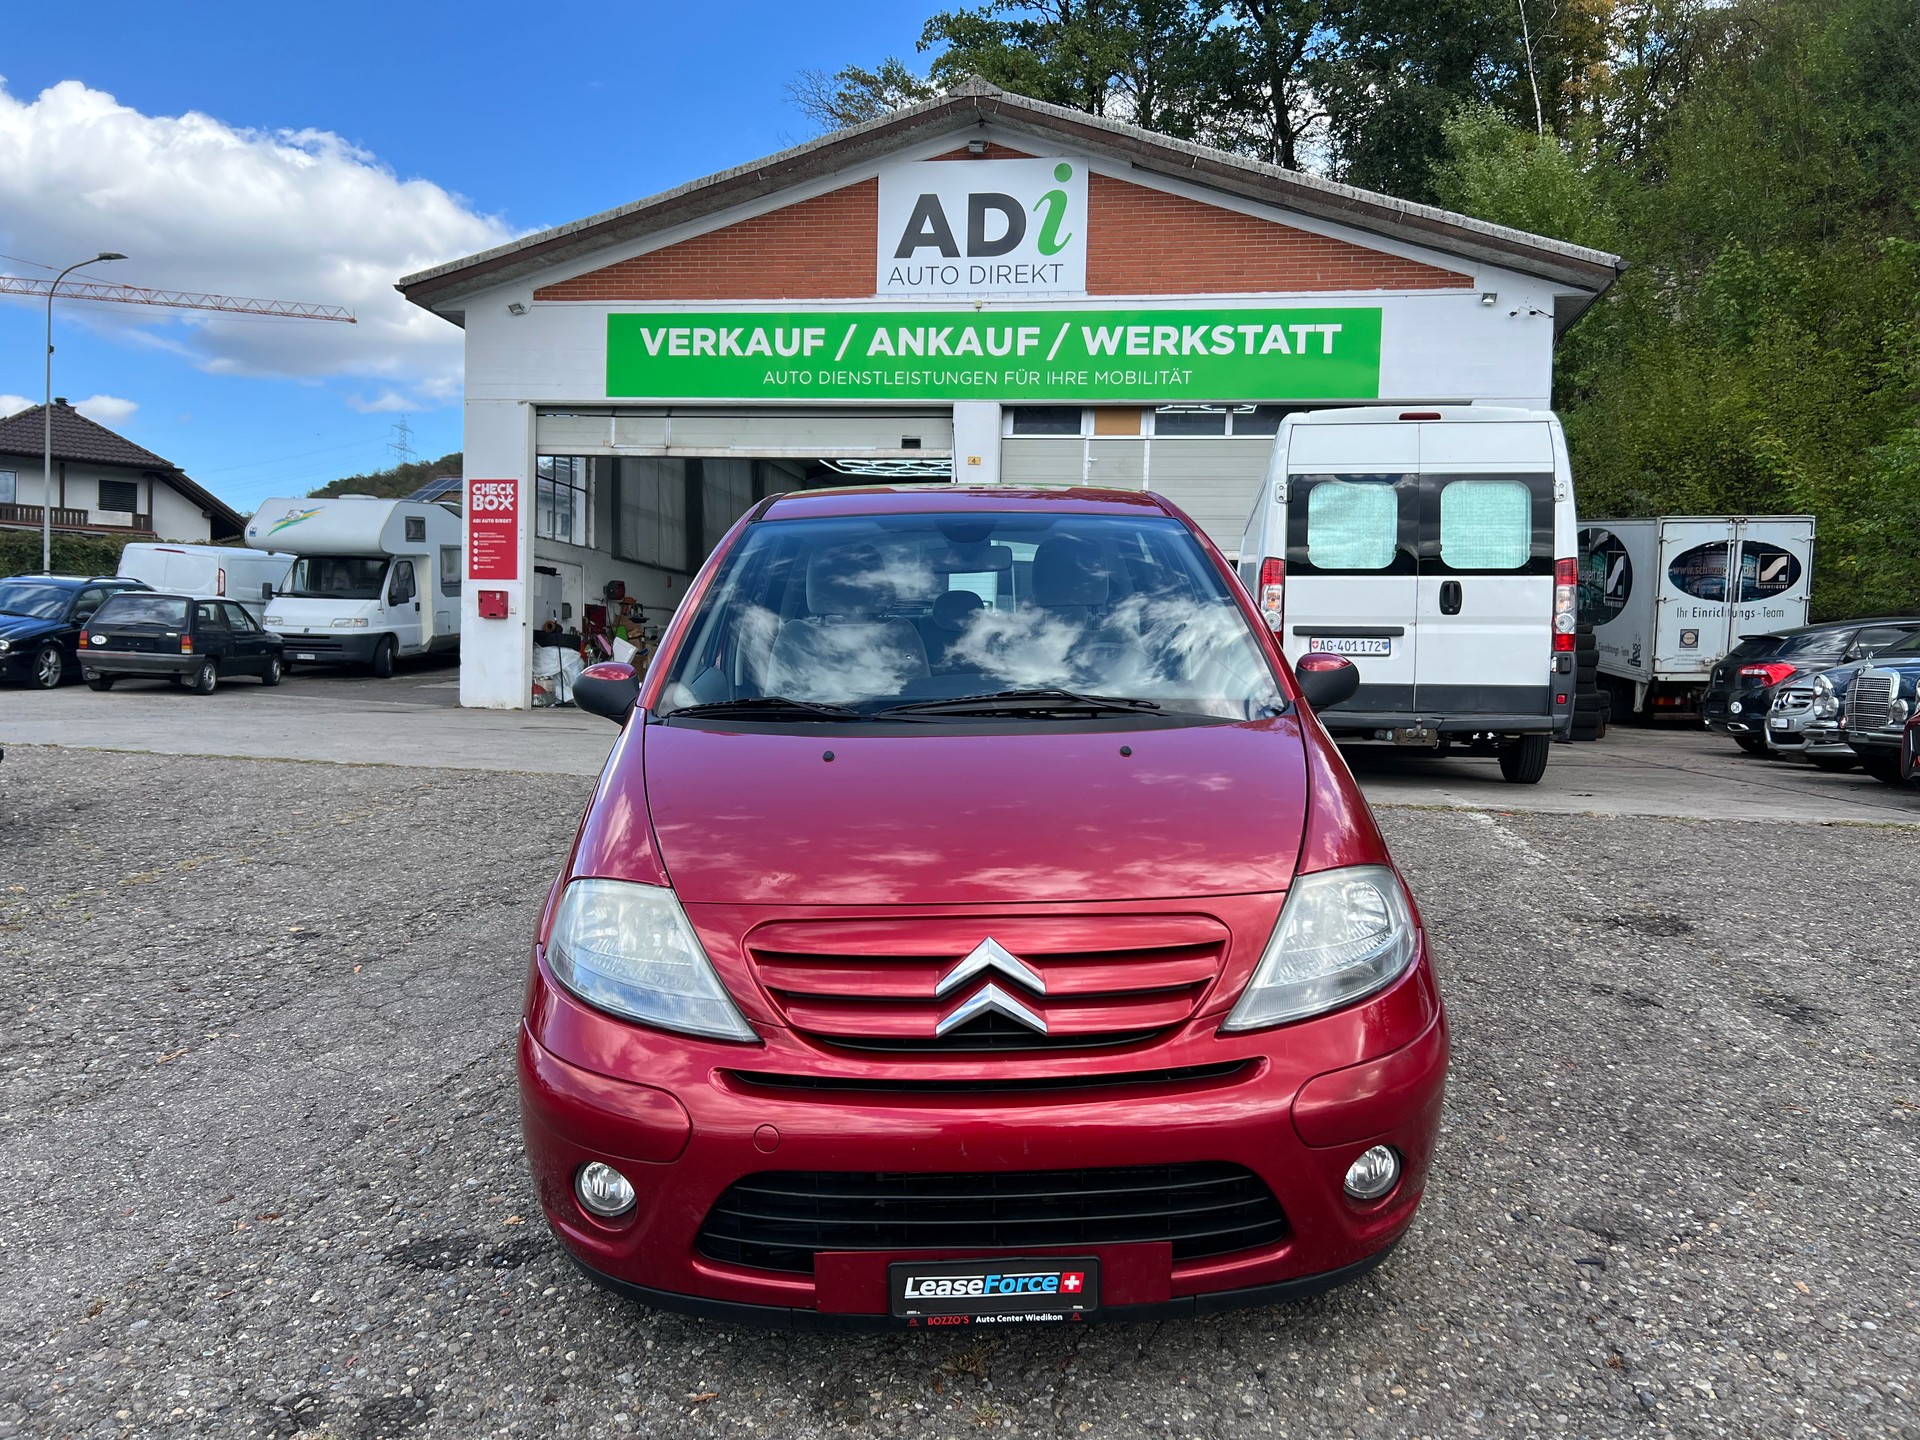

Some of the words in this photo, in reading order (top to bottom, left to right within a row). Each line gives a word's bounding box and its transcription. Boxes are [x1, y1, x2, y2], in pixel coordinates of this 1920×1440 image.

[893, 162, 1073, 258] ADi
[887, 265, 960, 286] AUTO
[969, 263, 1065, 285] DIREKT
[639, 327, 826, 357] VERKAUF
[833, 323, 858, 362] /
[866, 326, 1041, 357] ANKAUF
[1045, 322, 1071, 361] /
[1081, 324, 1343, 356] WERKSTATT
[762, 370, 813, 385] AUTO
[818, 371, 998, 386] DIENSTLEISTUNGEN
[1004, 368, 1041, 385] FÜR
[1046, 371, 1088, 385] IHRE
[1094, 367, 1193, 385] MOBILITÄT
[472, 483, 515, 495] CHECK
[472, 494, 515, 511] BOX
[1676, 606, 1688, 618] Ihr
[905, 1274, 1059, 1296] LeaseForce
[975, 1315, 996, 1324] Auto
[996, 1313, 1024, 1323] Center
[1023, 1311, 1064, 1322] Wiedikon
